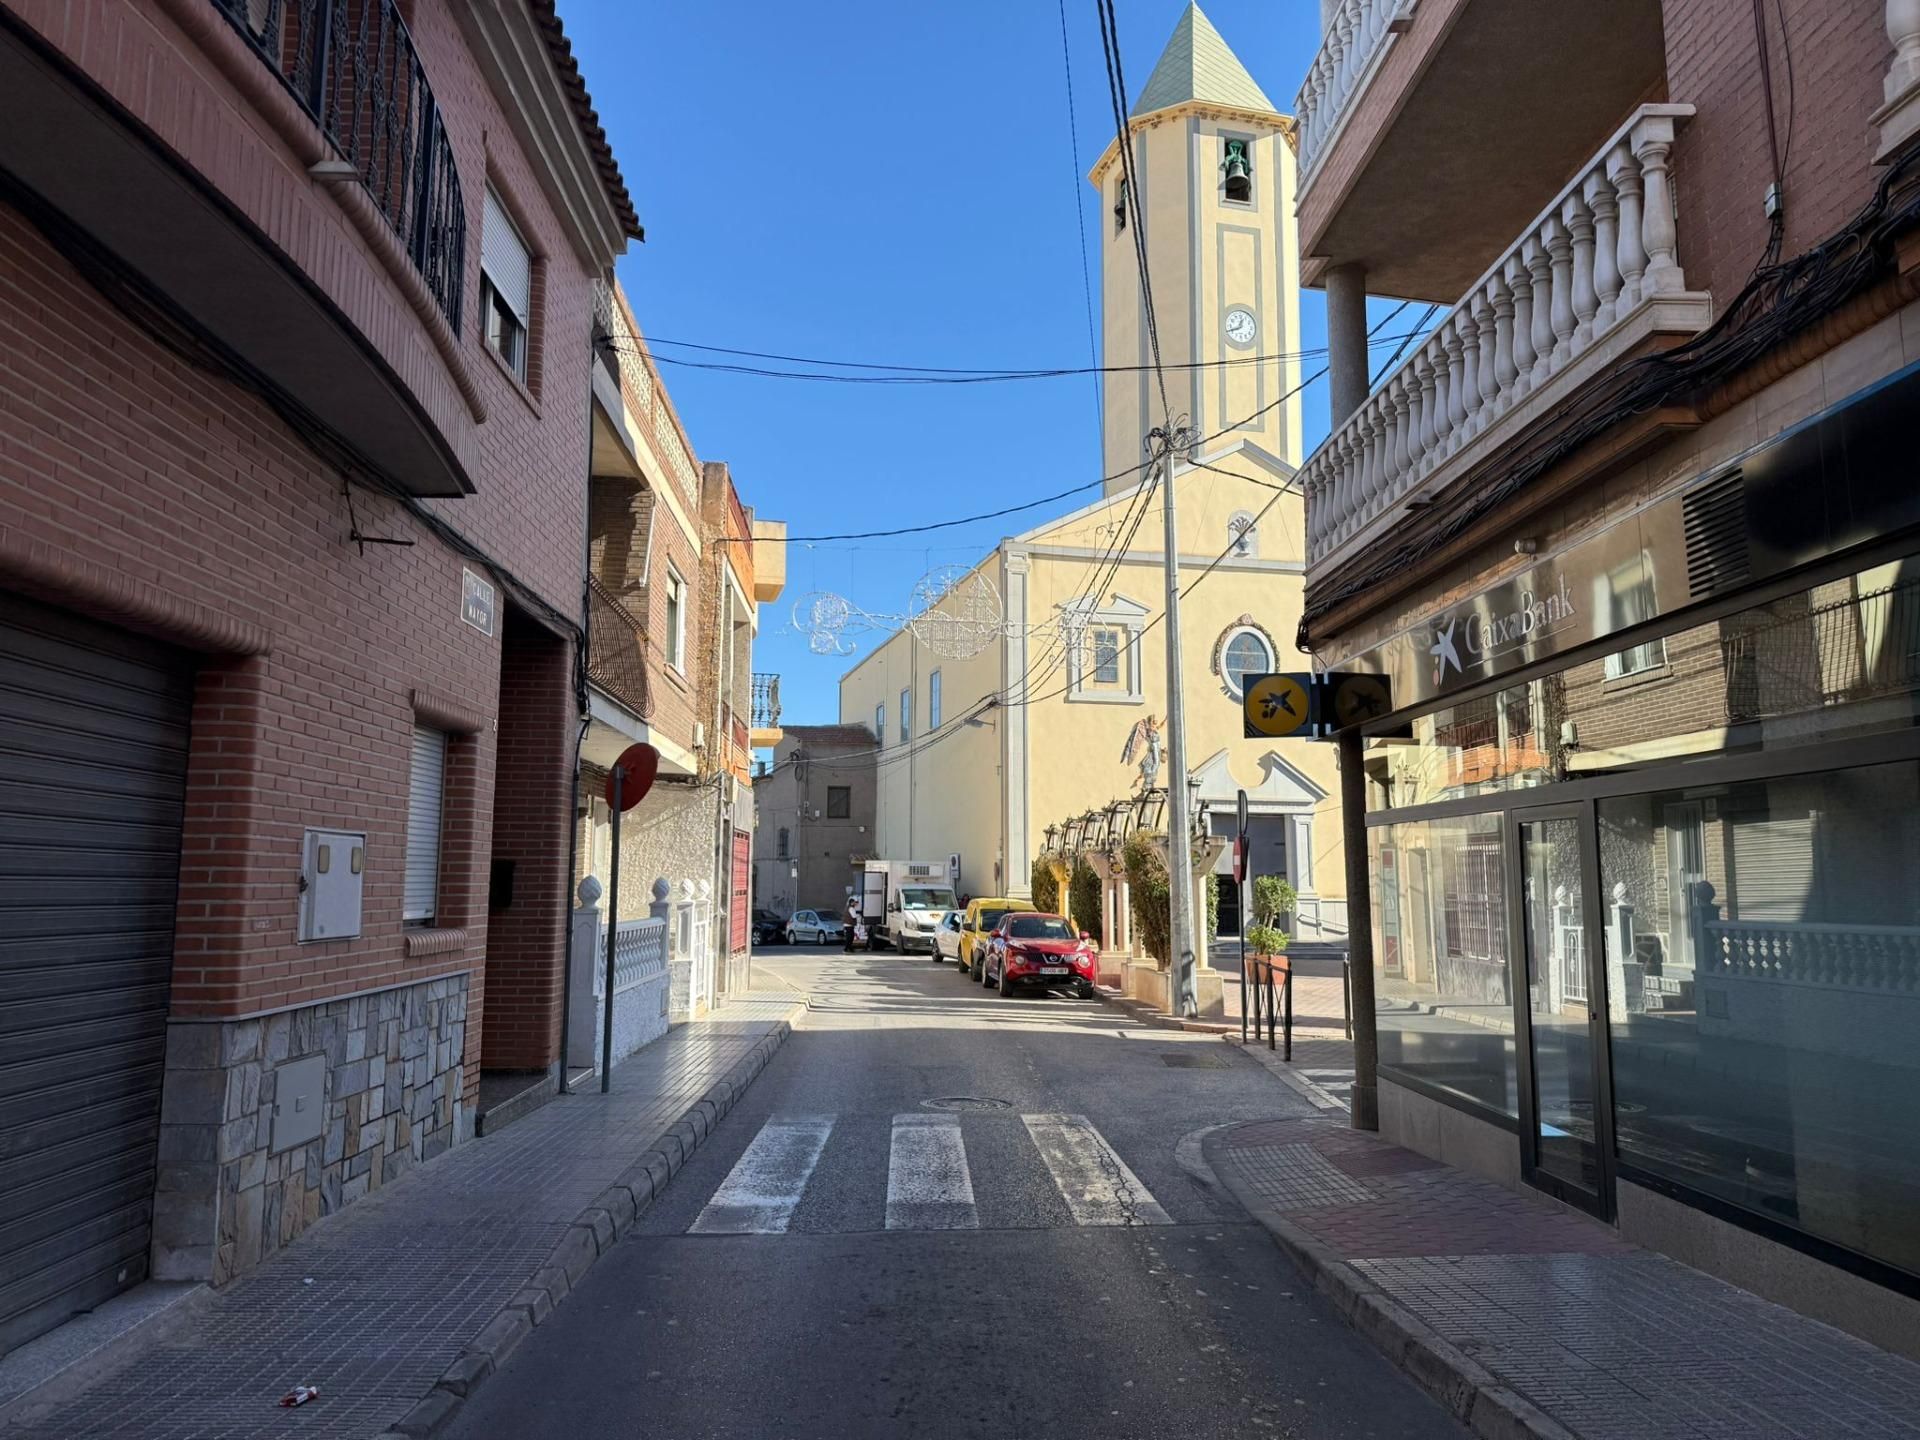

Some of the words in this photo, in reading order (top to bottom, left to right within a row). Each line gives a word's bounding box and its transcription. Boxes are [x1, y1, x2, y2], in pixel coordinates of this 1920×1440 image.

[473, 583, 490, 605] CALLE
[468, 605, 487, 626] MAYOR
[1465, 572, 1576, 654] CaixaBank
